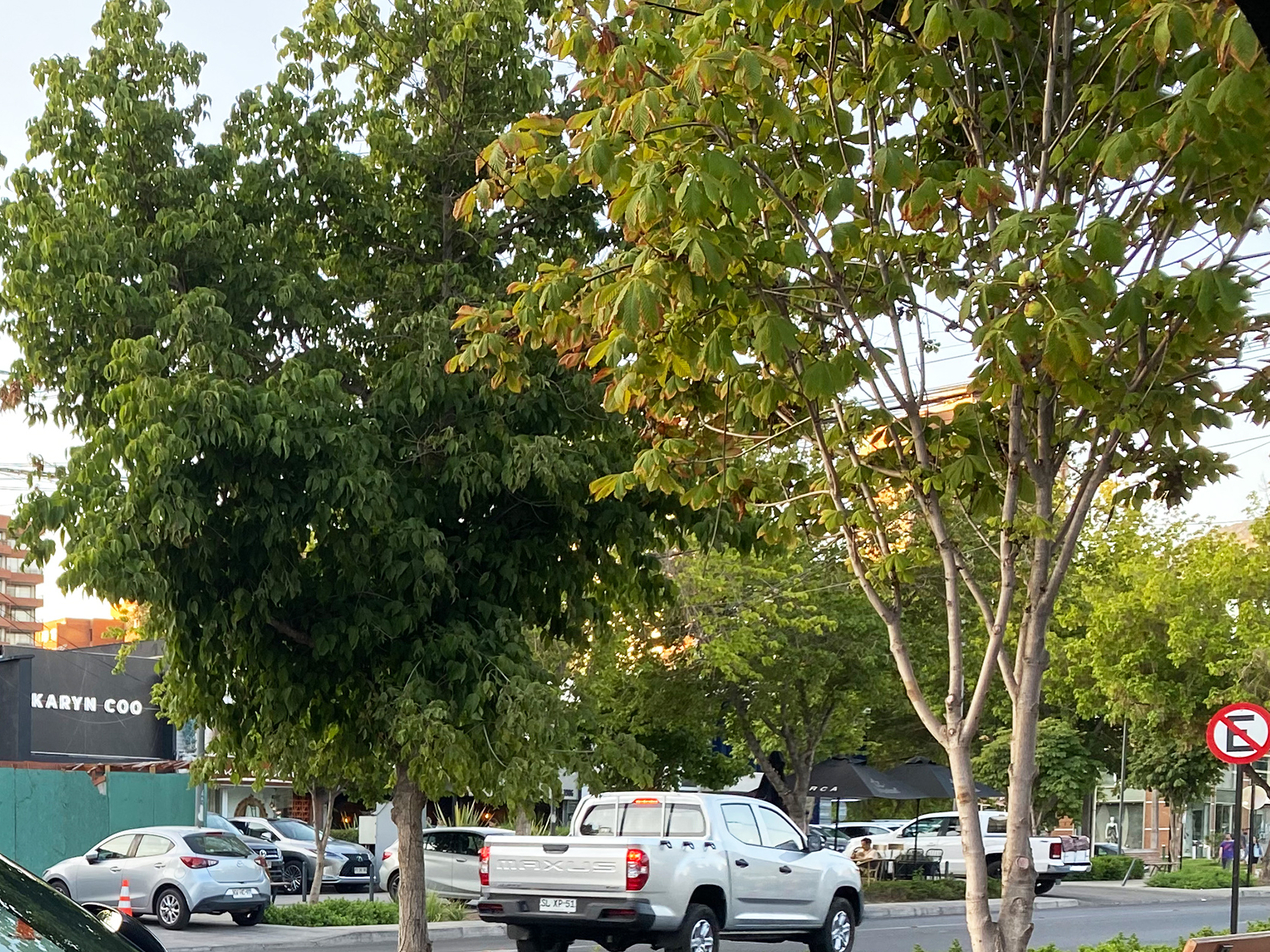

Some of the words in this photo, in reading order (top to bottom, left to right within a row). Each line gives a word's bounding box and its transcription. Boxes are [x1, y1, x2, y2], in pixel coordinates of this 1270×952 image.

[31, 692, 97, 712] KARYN
[103, 698, 143, 716] COO
[496, 859, 616, 873] MAXUS
